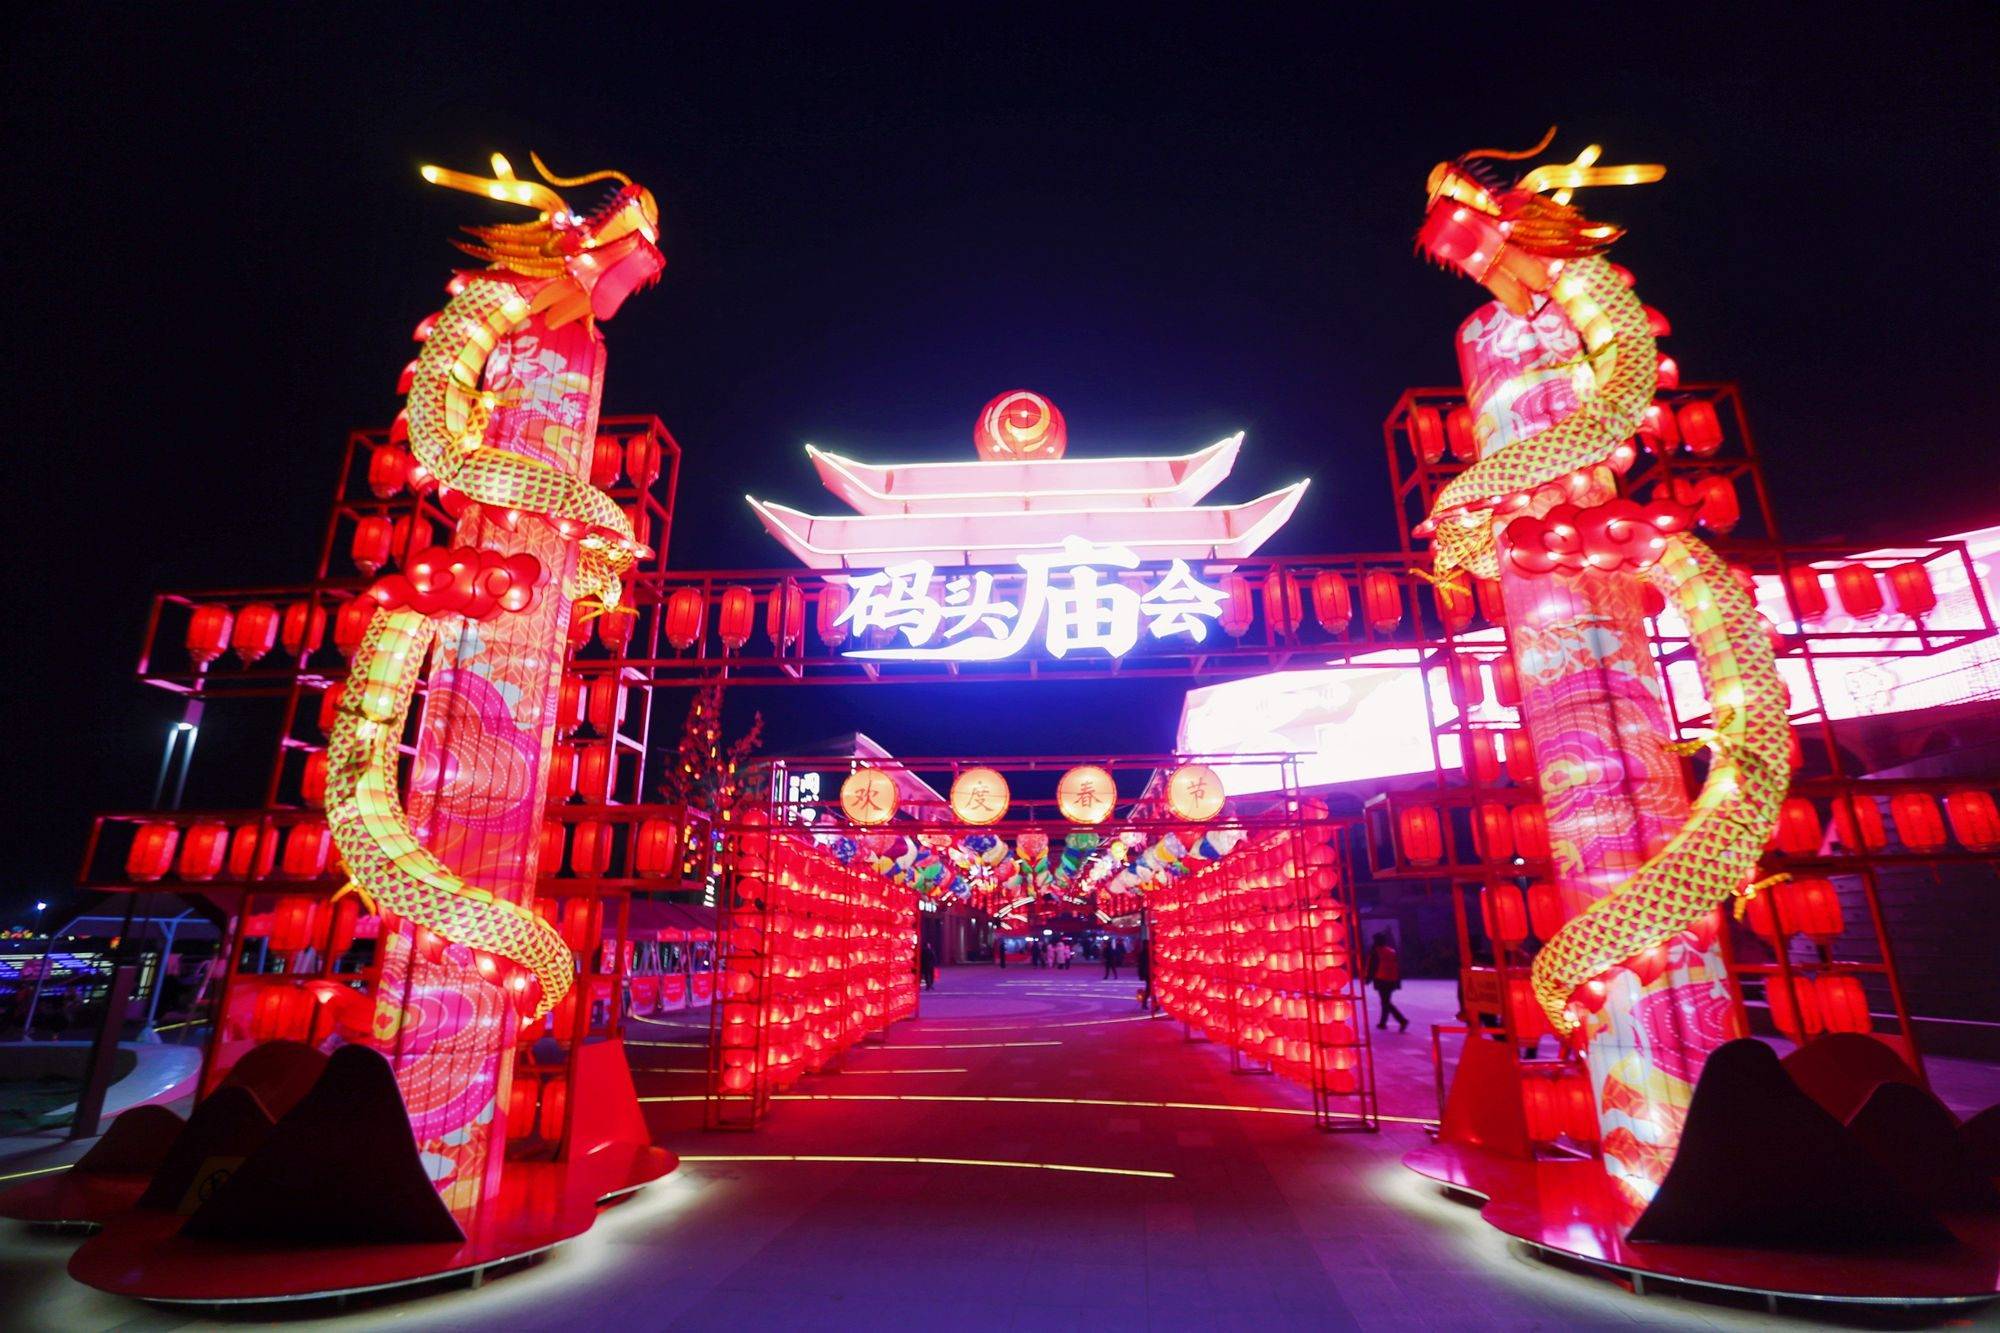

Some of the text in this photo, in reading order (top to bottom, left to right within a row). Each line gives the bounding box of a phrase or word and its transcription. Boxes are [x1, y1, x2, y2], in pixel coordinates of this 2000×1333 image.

[832, 534, 1231, 661] 码头庙会
[851, 779, 883, 811] 欢
[965, 780, 994, 812] 度
[1074, 780, 1104, 808] 春
[1186, 776, 1207, 809] 节
